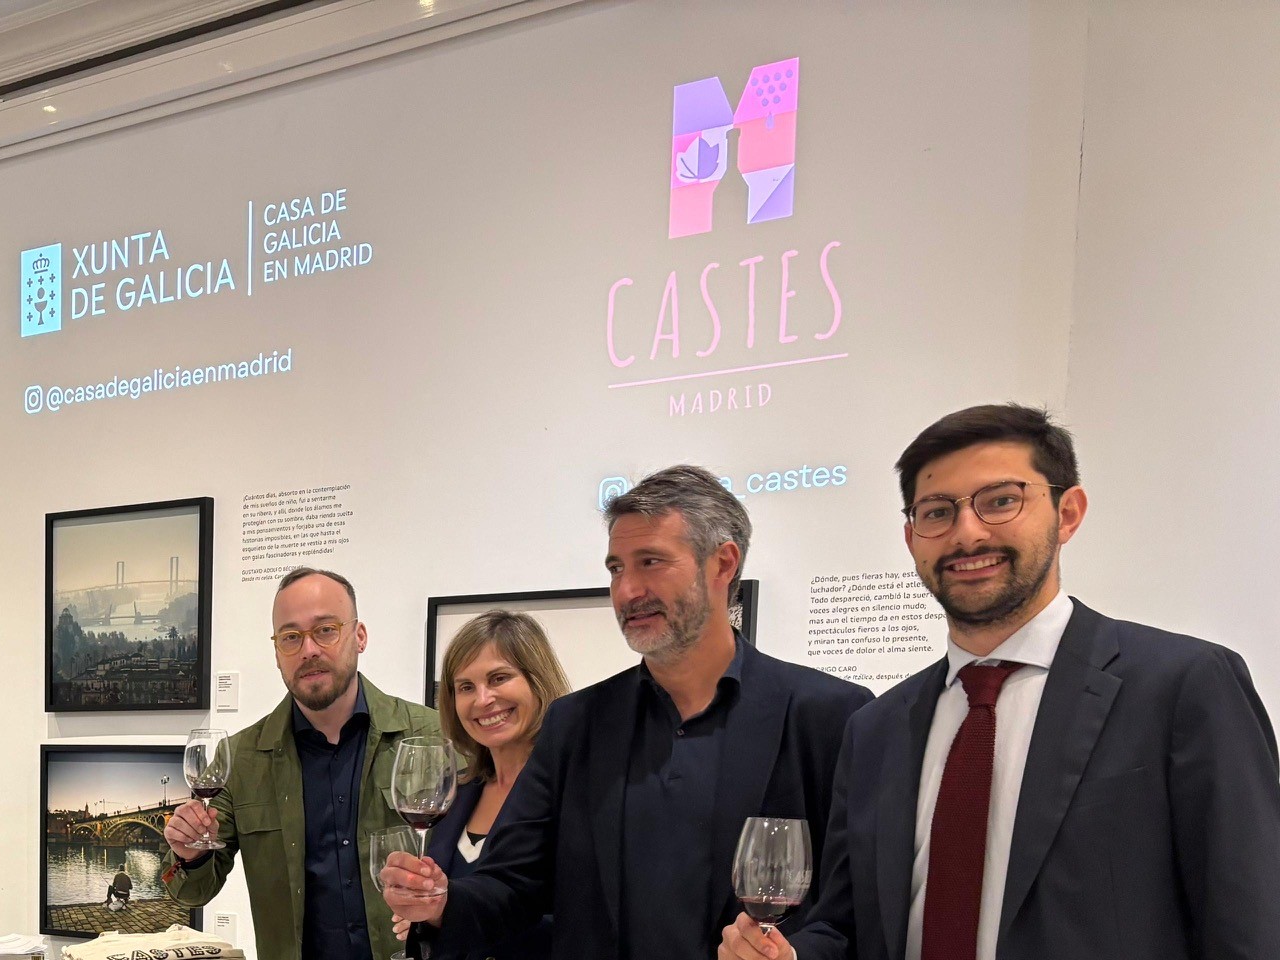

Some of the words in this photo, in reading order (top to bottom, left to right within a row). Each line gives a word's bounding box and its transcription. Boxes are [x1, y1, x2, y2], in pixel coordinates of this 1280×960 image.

[263, 196, 314, 226] CASA
[321, 188, 347, 213] DE
[72, 229, 170, 279] XUNTA
[263, 219, 341, 255] GALICIA
[263, 259, 287, 283] EN
[295, 242, 373, 276] MADRID
[71, 285, 105, 320] DE
[116, 258, 235, 311] GALICIA
[606, 241, 843, 368] CASTES
[46, 348, 292, 411] @casadegaliciaenmadrid
[669, 383, 773, 417] MADRID
